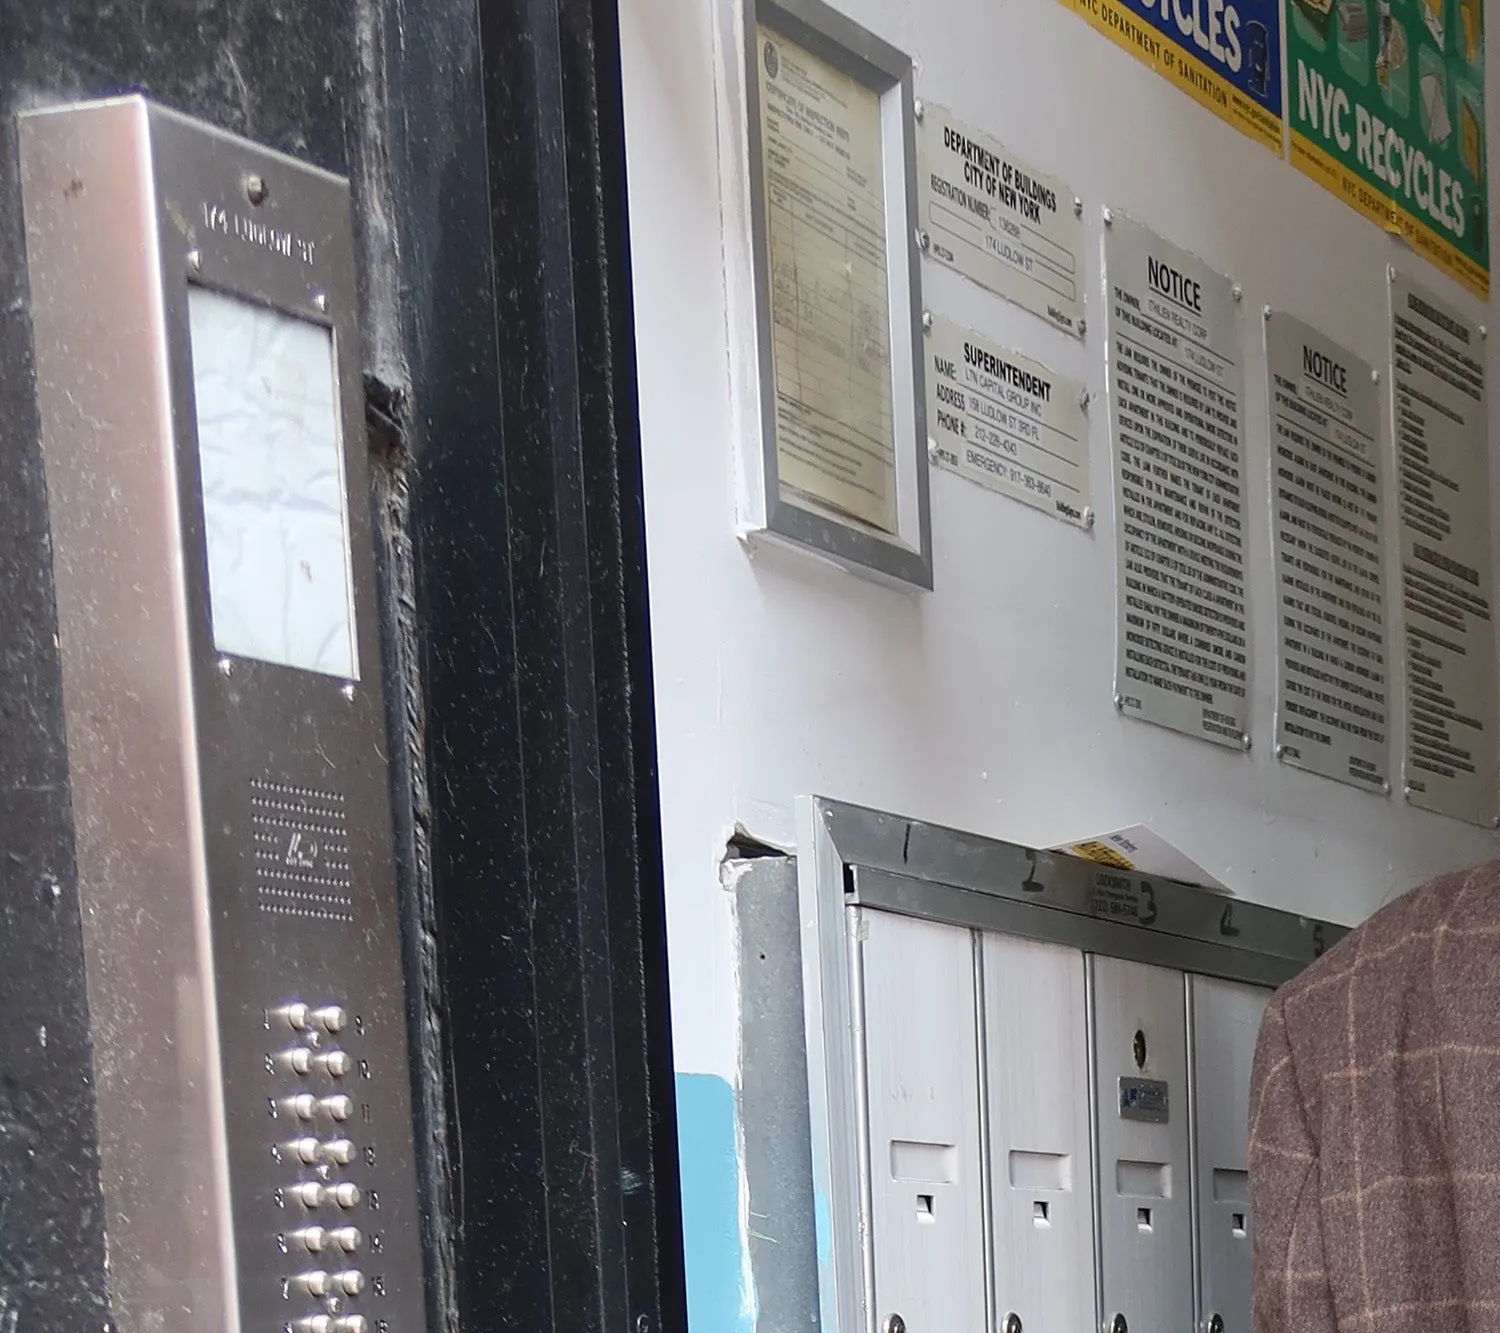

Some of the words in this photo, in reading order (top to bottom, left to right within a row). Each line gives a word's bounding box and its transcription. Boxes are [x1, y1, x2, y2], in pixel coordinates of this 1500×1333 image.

[1101, 6, 1161, 59] DEPARTMENT
[1163, 50, 1174, 68] OF
[1179, 61, 1227, 108] SANITATION
[944, 126, 1000, 172] DEPARTMENT
[1002, 162, 1012, 184] OF
[1014, 167, 1056, 213] BUILDINGS
[1298, 59, 1350, 151] NYC
[1356, 104, 1465, 238] RECYCLES
[931, 174, 966, 207] REGISTRATION
[964, 161, 984, 190] CITY
[986, 173, 996, 198] OF
[999, 182, 1017, 213] NEW
[1018, 195, 1040, 225] YORK
[997, 239, 1023, 267] LUDLOW
[1025, 255, 1033, 271] ST
[1148, 255, 1202, 312] NOTICE
[934, 355, 957, 381] NAME:
[979, 373, 1005, 400] CAPITAL
[1006, 388, 1029, 411] GROUP
[964, 342, 1051, 402] SUPERINTENDENT
[1303, 345, 1347, 393] NOTICE
[937, 409, 959, 436] PHONE
[981, 402, 1007, 427] LUDLOW
[1009, 413, 1017, 430] ST
[1022, 850, 1045, 892] 2
[1139, 881, 1157, 926] 3
